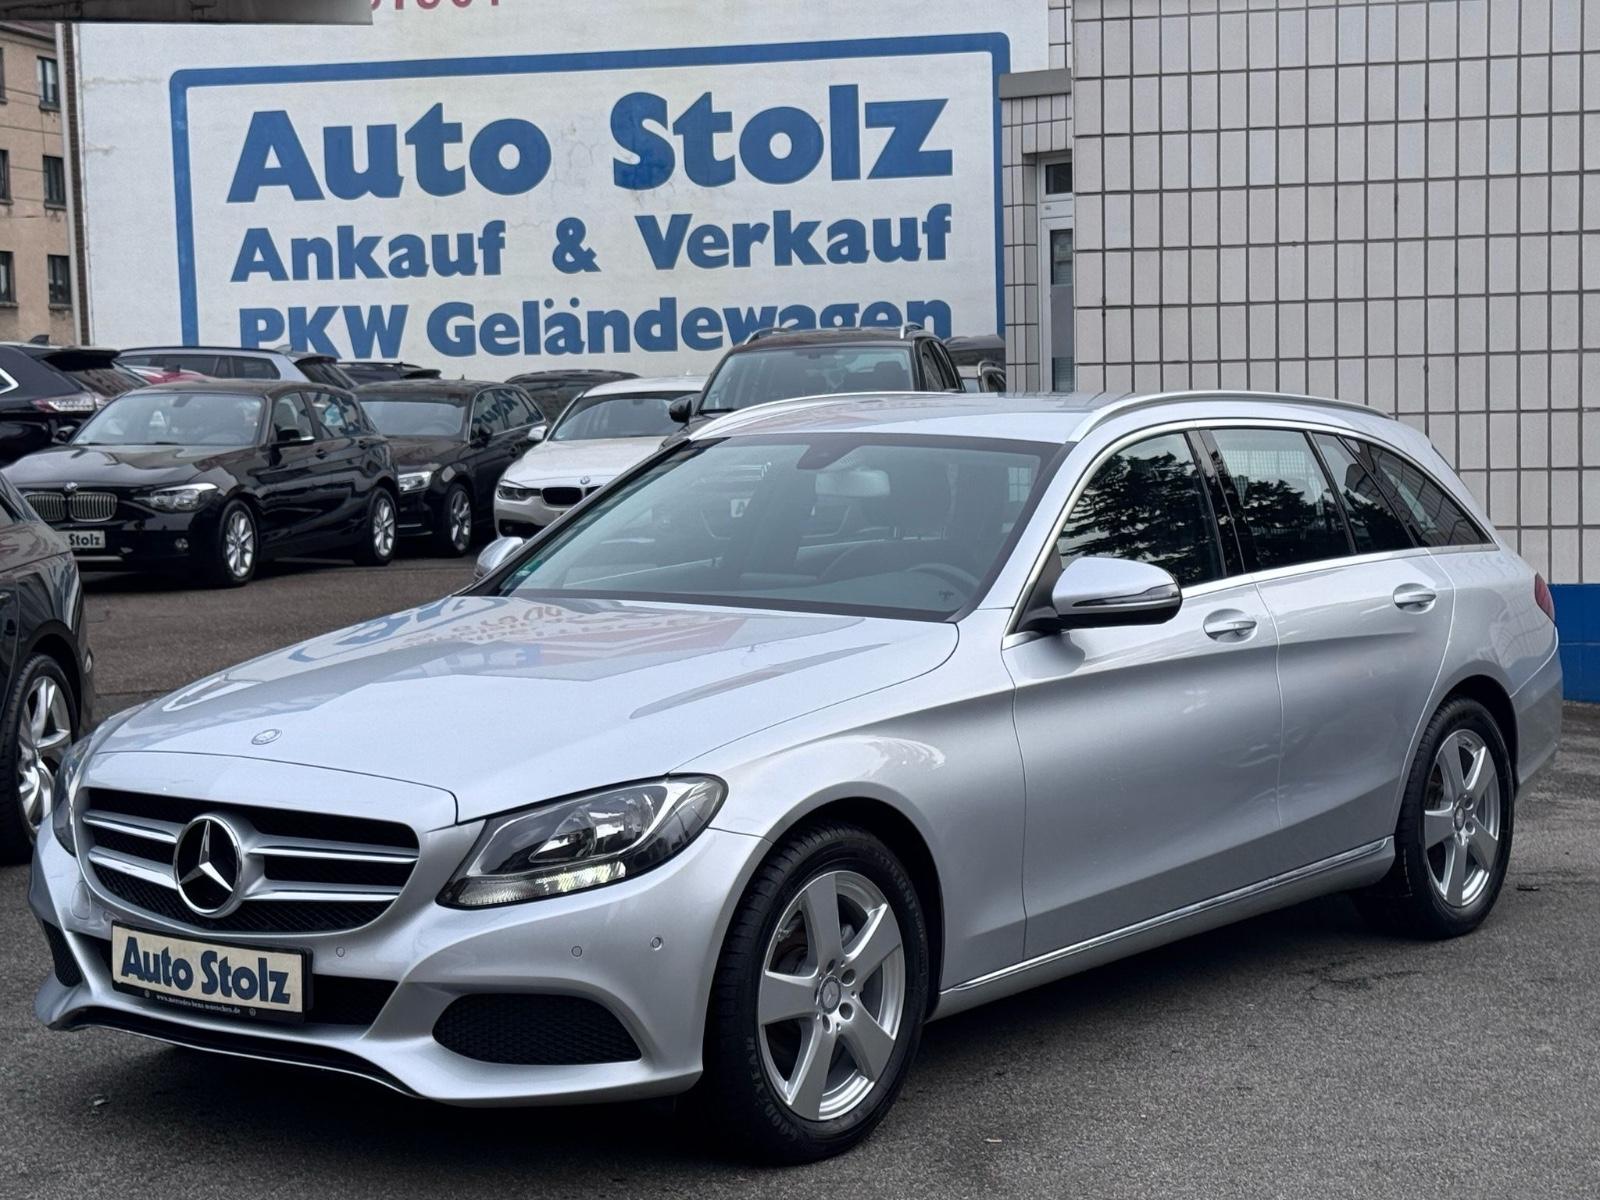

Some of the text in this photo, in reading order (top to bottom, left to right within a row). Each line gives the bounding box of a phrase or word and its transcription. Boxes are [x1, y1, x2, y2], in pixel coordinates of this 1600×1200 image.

[227, 84, 953, 203] Auto Stolz
[230, 203, 952, 282] Ankauf & Verkauf
[240, 304, 408, 359] PKW
[68, 533, 101, 546] Stolz
[121, 936, 291, 1004] Auto Stolz
